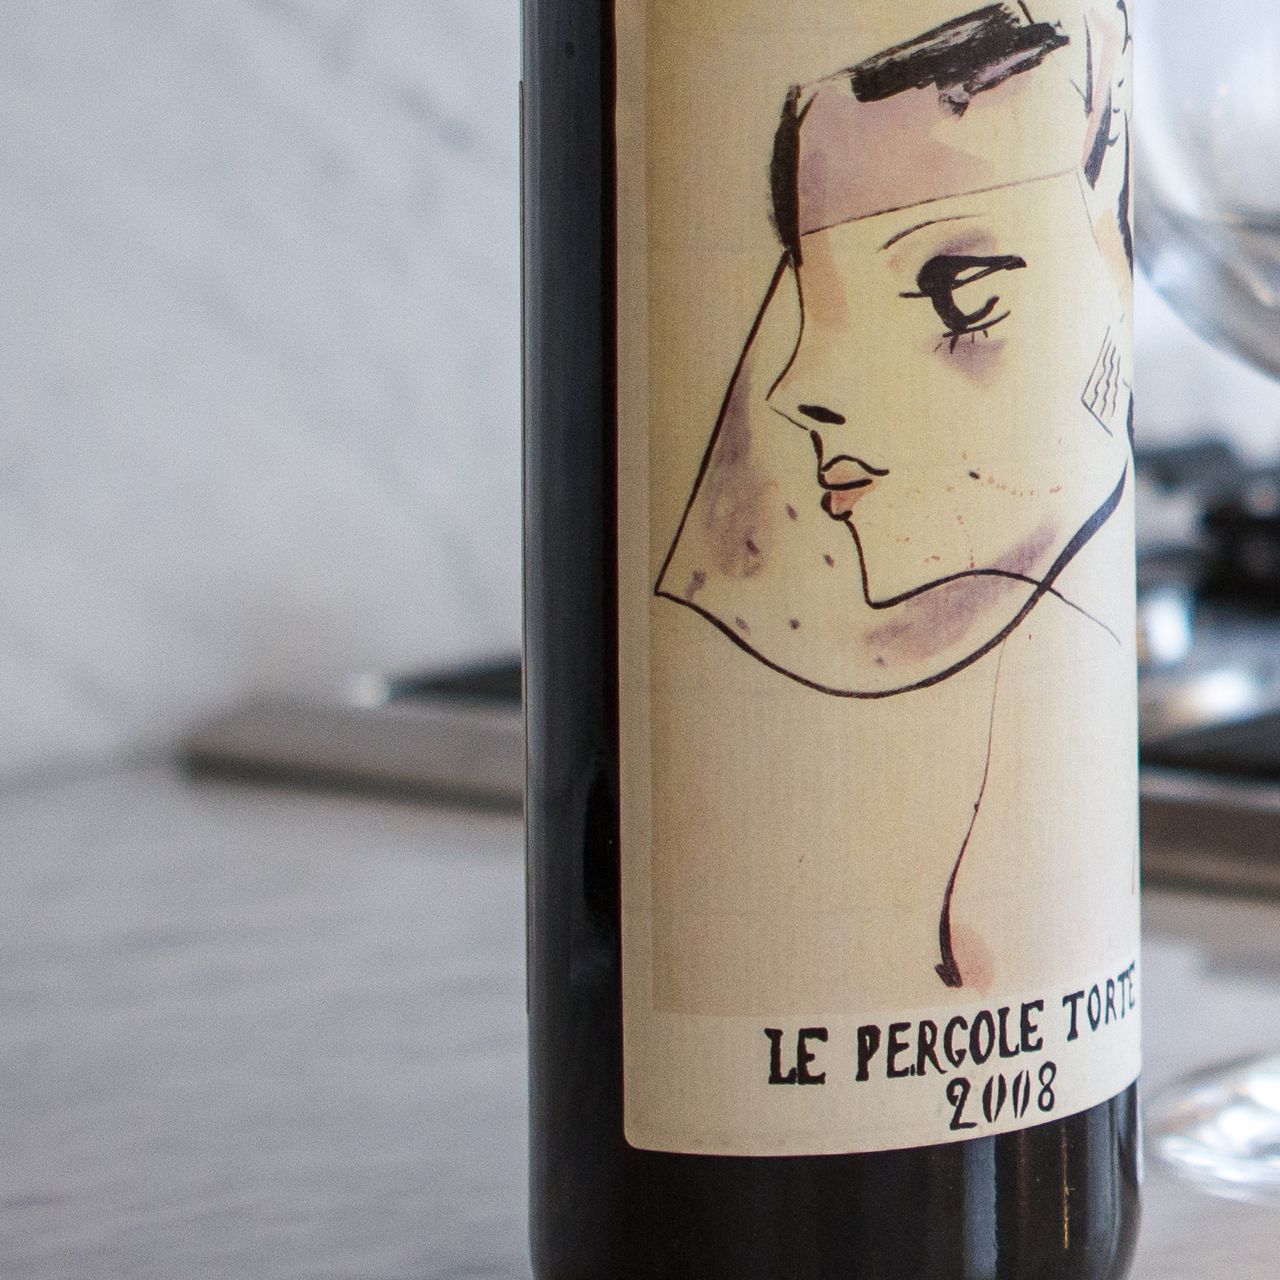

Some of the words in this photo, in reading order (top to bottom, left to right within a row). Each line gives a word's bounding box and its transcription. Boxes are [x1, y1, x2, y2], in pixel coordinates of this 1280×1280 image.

[764, 1027, 828, 1085] LE
[855, 999, 1045, 1081] PERGOLE
[1062, 960, 1136, 1042] TORTE
[945, 1061, 1057, 1131] 2008
